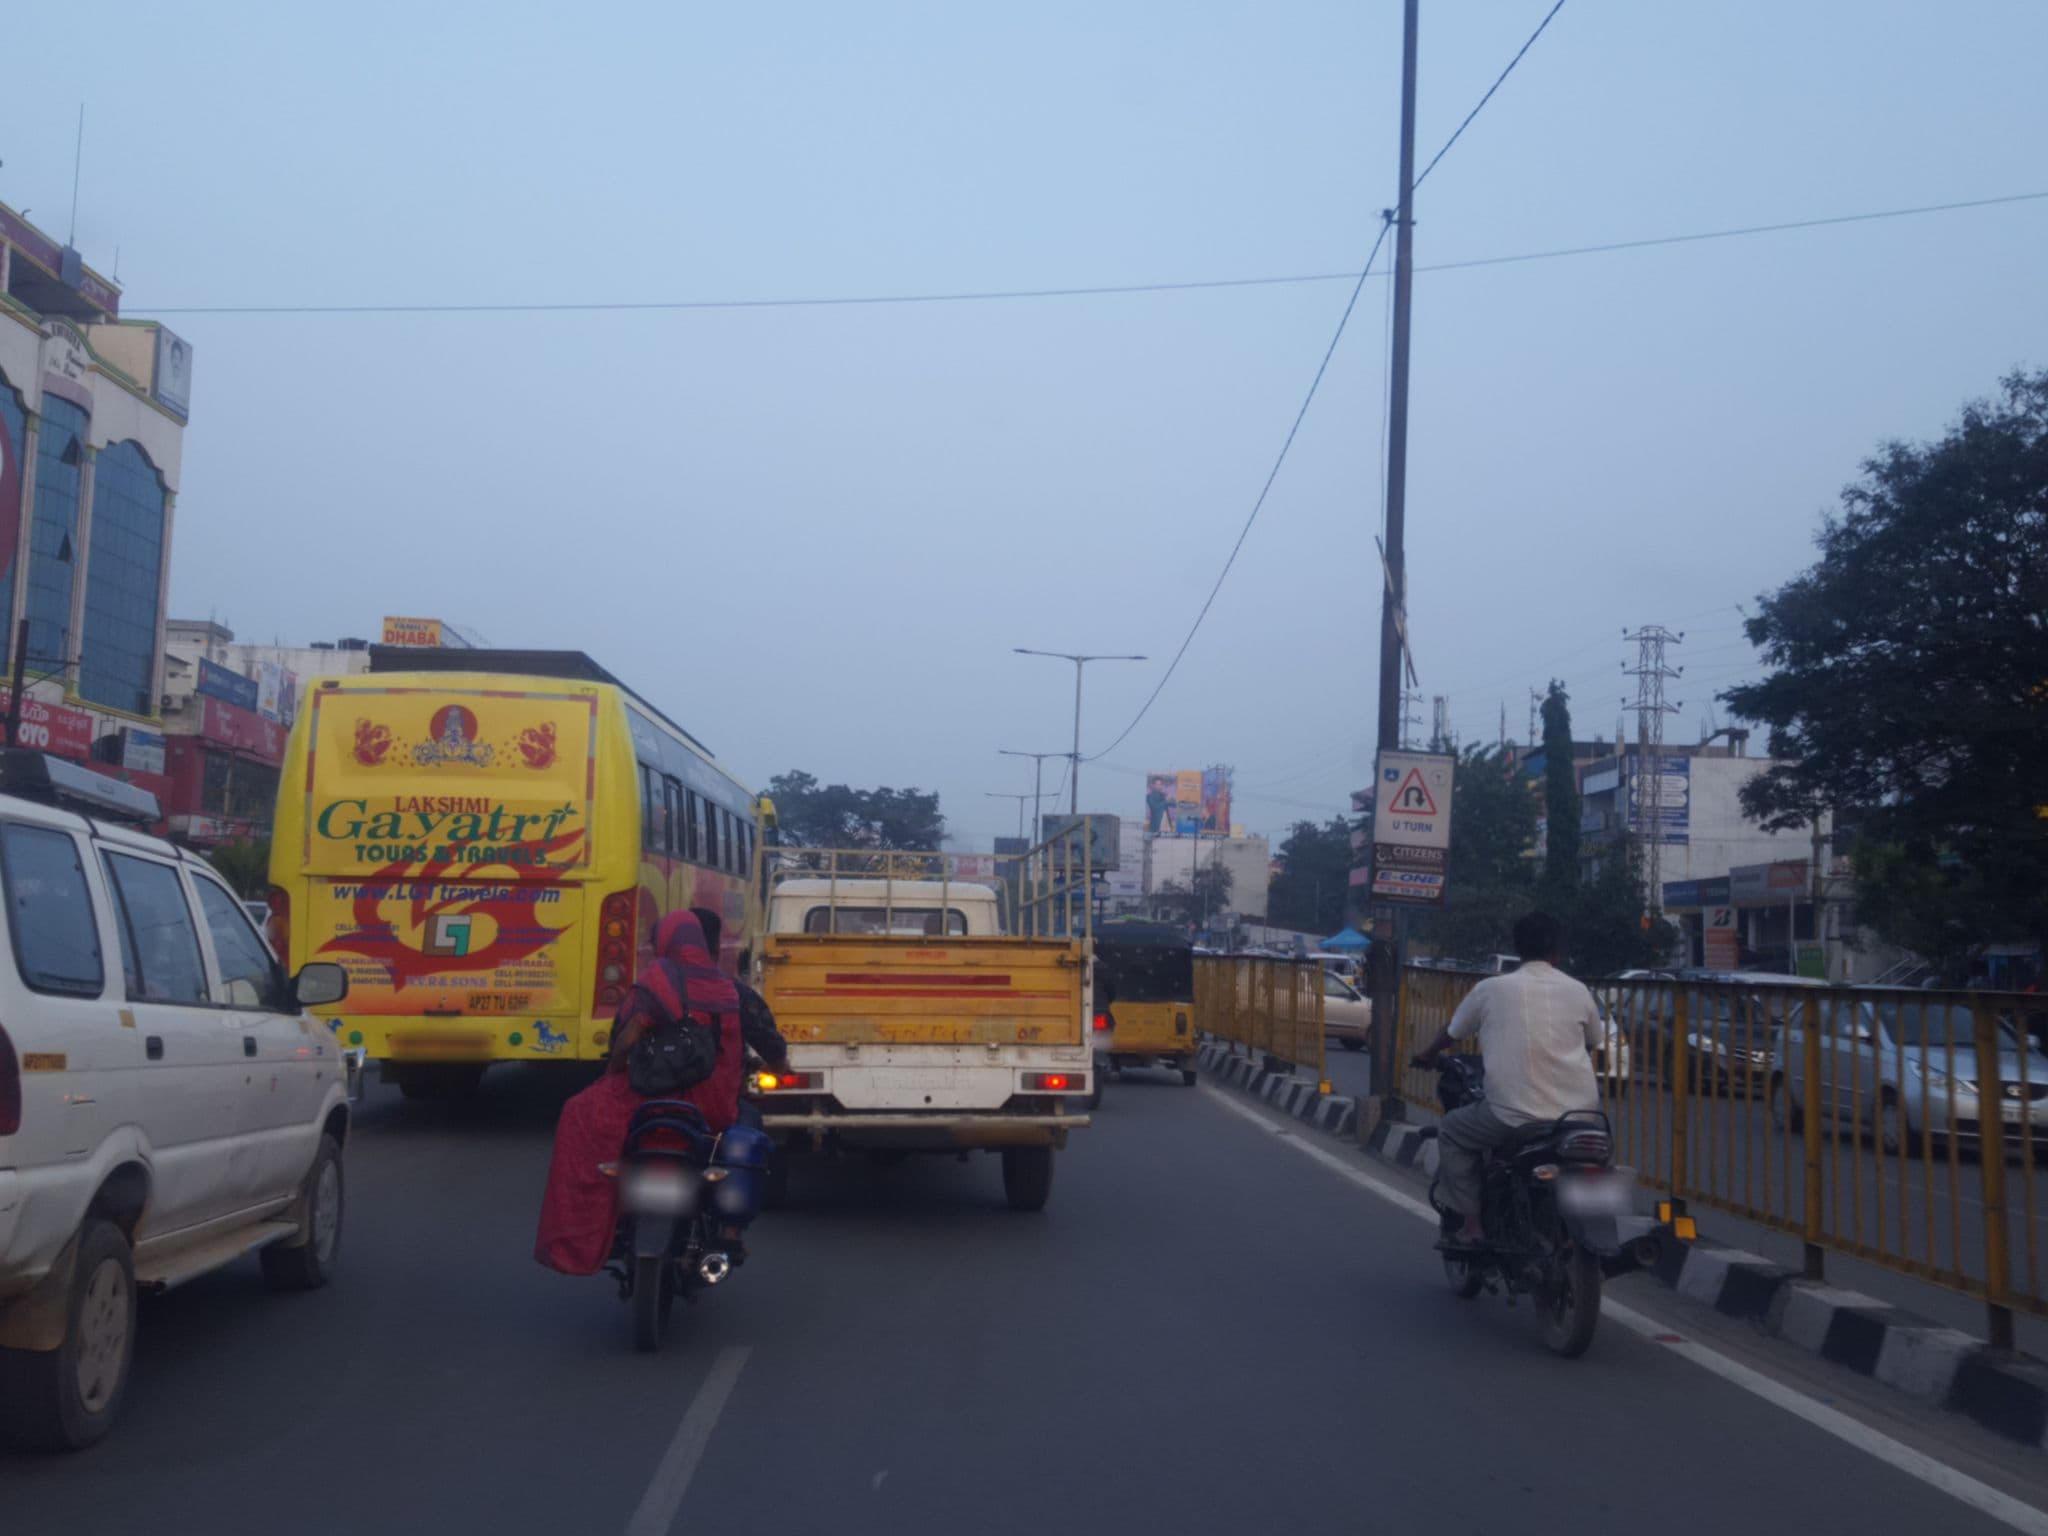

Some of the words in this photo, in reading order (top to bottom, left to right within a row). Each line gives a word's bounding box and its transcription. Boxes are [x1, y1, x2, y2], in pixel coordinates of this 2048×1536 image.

[385, 630, 437, 646] DHABA
[18, 722, 49, 747] OYO
[394, 796, 491, 814] LAKSHMI
[317, 799, 578, 842] Gayatri
[1393, 821, 1400, 830] U
[1404, 822, 1433, 833] TURN
[355, 845, 428, 863] TOURS
[455, 846, 547, 866] TRAVELS
[1392, 848, 1442, 860] CITIZENS
